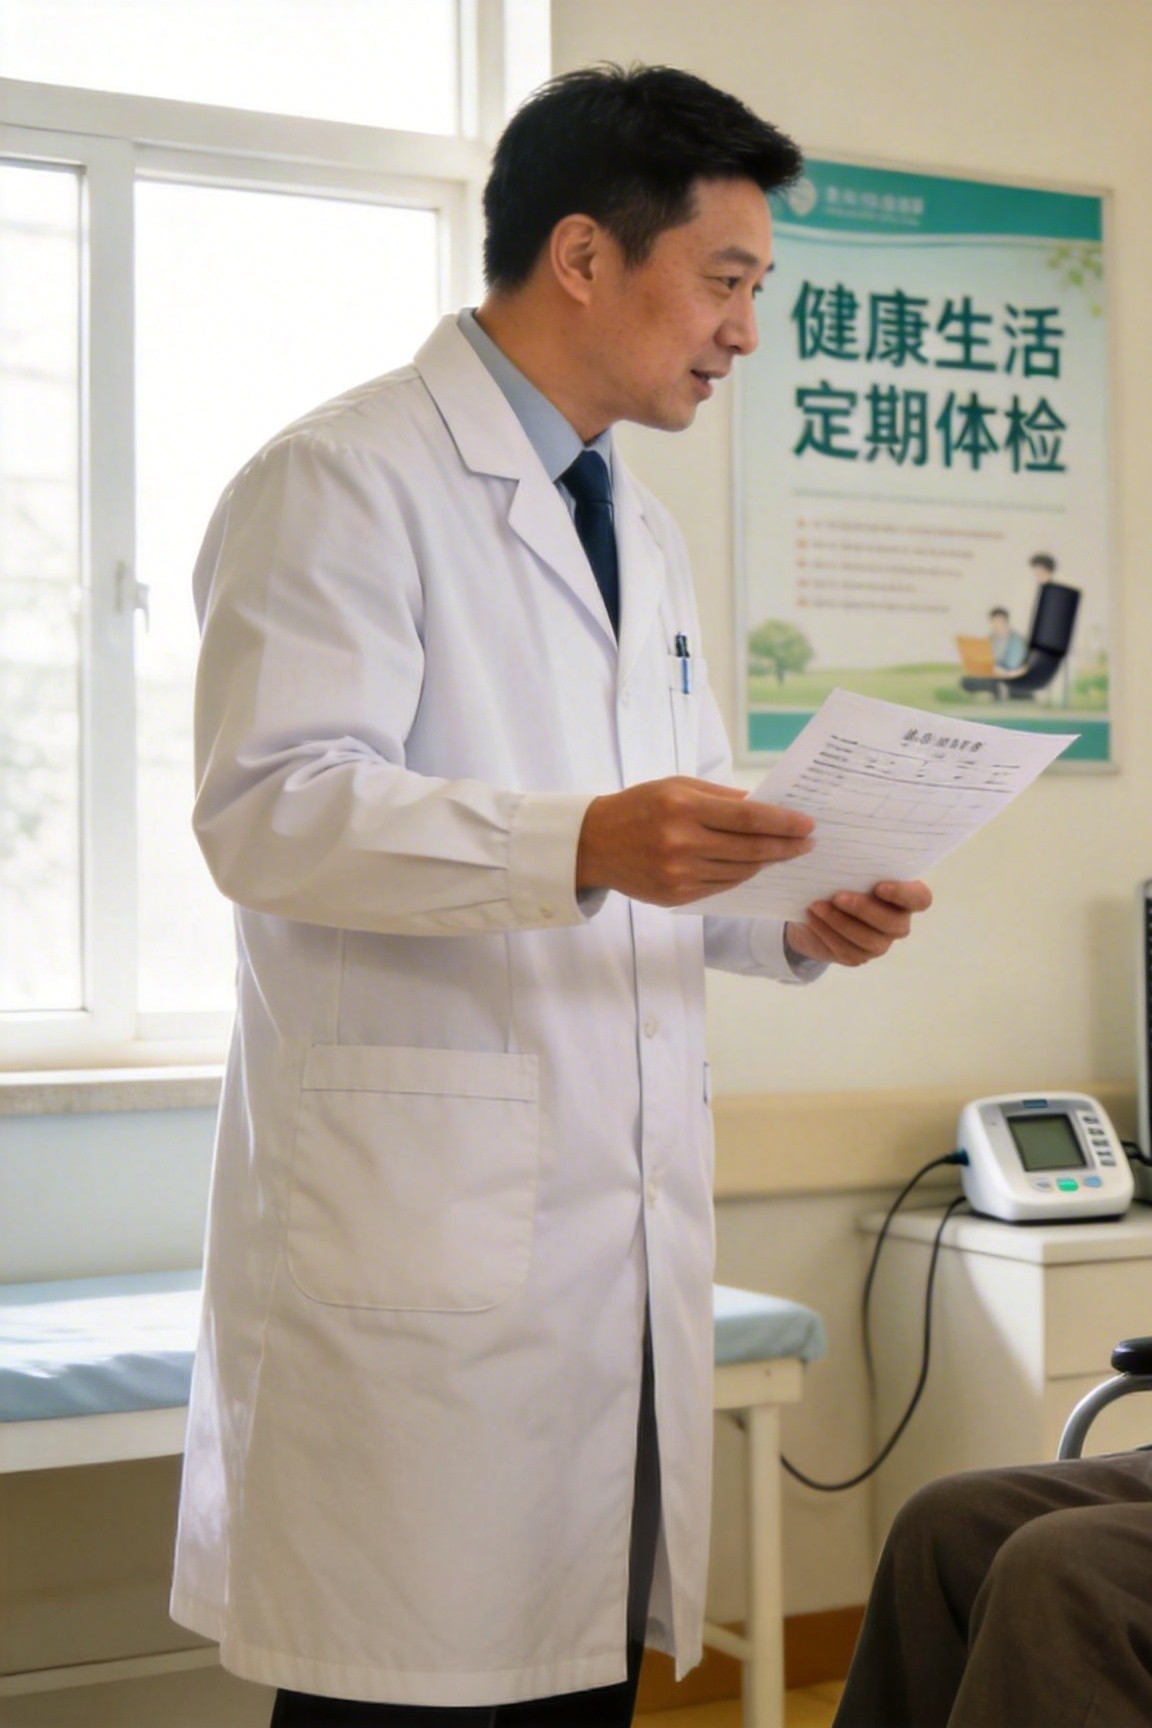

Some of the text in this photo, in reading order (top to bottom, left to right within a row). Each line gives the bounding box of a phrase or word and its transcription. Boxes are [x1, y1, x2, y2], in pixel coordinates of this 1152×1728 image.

[791, 280, 1064, 379] 健康生活
[792, 380, 1067, 474] 定期体检
